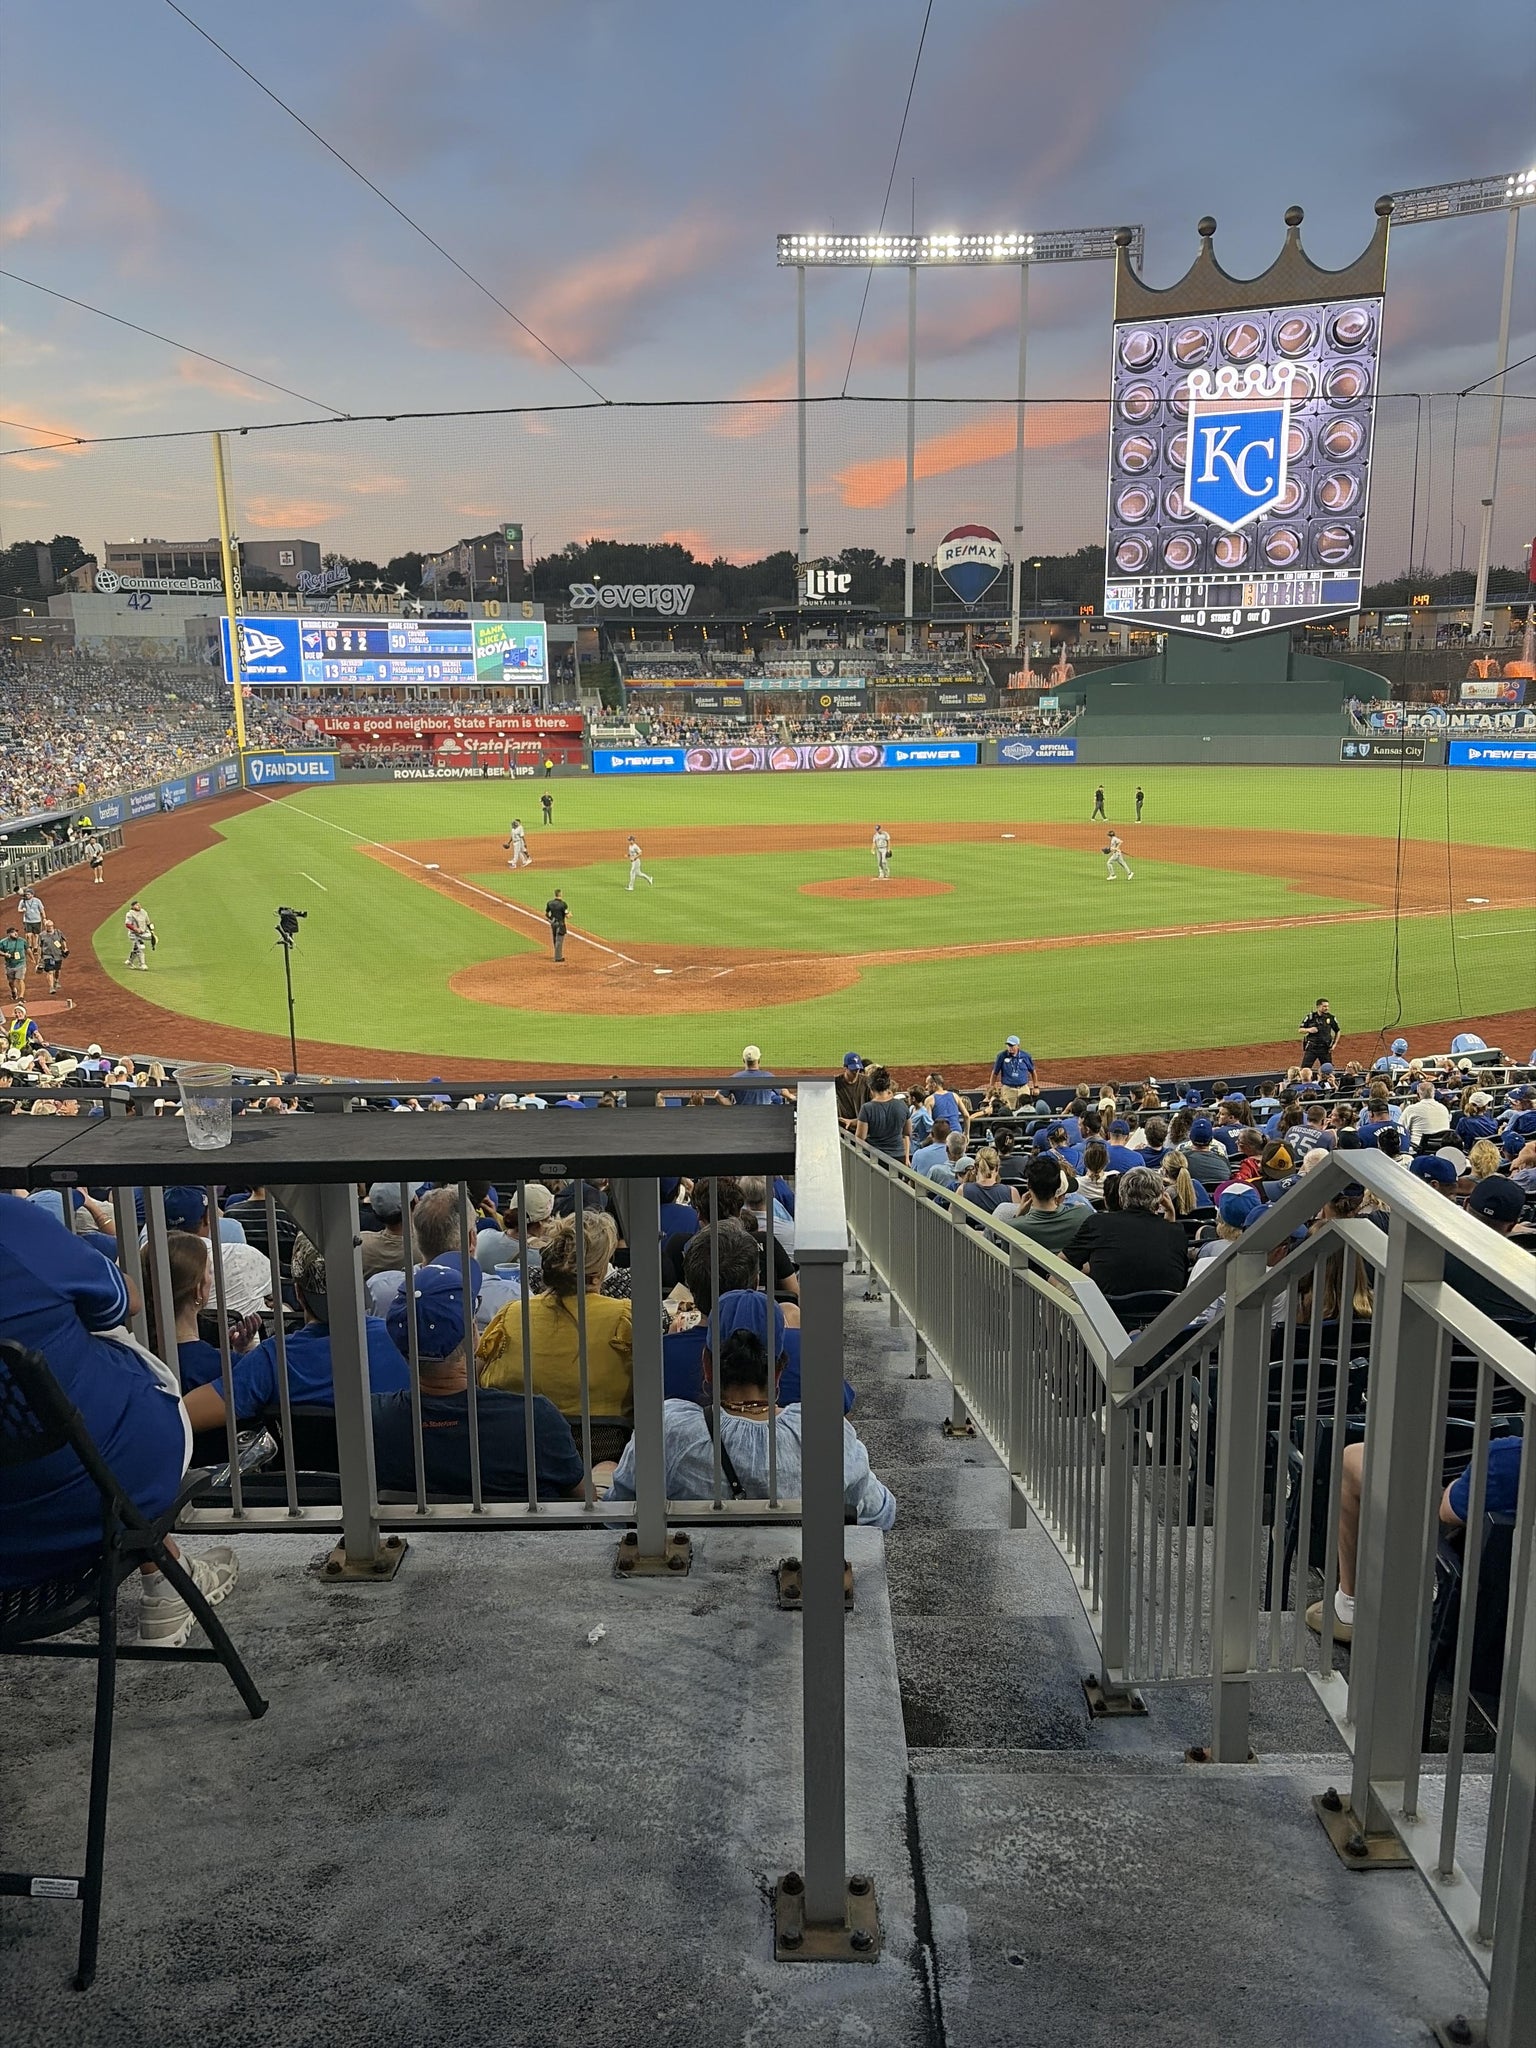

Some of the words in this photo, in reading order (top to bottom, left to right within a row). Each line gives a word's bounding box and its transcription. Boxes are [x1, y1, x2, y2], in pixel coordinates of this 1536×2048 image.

[1197, 425, 1274, 496] KC
[946, 545, 996, 560] RE/MAX
[121, 576, 187, 589] Commerce
[189, 577, 222, 590] Bank
[296, 565, 351, 595] Royals
[804, 570, 852, 600] Lite
[1118, 587, 1133, 598] TOR
[1137, 588, 1143, 598] 2
[1150, 587, 1155, 597] 0
[1162, 587, 1166, 597] 1
[1174, 586, 1179, 596] 0
[1186, 586, 1191, 596] 0
[1197, 585, 1203, 595] 0
[1248, 584, 1253, 593] 3
[1260, 584, 1268, 593] 10
[1273, 583, 1278, 593] 0
[1285, 583, 1291, 592] 7
[1299, 582, 1304, 592] 3
[1312, 582, 1316, 591] 1
[128, 593, 152, 610] 42
[246, 590, 312, 611] HALL
[316, 595, 336, 615] of
[337, 593, 401, 613] FAME
[601, 588, 691, 612] evergy
[1119, 600, 1131, 610] KC
[1137, 600, 1143, 609] 2
[1149, 599, 1155, 609] 0
[1161, 599, 1166, 608] 0
[1174, 598, 1178, 608] 1
[1185, 598, 1191, 608] 0
[1248, 597, 1252, 605] 3
[1260, 596, 1265, 605] 4
[1273, 596, 1277, 604] 1
[1285, 595, 1290, 604] 3
[1298, 594, 1303, 604] 3
[1312, 594, 1315, 603] 1
[1413, 594, 1430, 605] 1:49
[482, 600, 500, 617] 10
[522, 601, 534, 617] 5
[1080, 605, 1094, 616] 1:49
[1180, 614, 1195, 623] BALL
[1197, 610, 1206, 626] 0
[1210, 613, 1231, 622] STRIKE
[1232, 610, 1241, 625] 0
[1247, 613, 1260, 621] OUT
[1261, 609, 1270, 624] 0
[480, 624, 504, 637] BANK
[327, 637, 336, 650] 0
[343, 637, 351, 650] 2
[359, 637, 367, 650] 2
[391, 635, 406, 648] 50
[480, 634, 499, 646] LIKE
[501, 632, 507, 640] A
[477, 637, 517, 658] ROYAL
[325, 664, 339, 678] 13
[379, 664, 387, 678] 9
[427, 665, 440, 678] 19
[834, 695, 857, 703] planet
[324, 719, 350, 730] Like
[353, 722, 360, 730] a
[363, 718, 392, 732] good
[396, 717, 451, 731] neighbor,
[454, 716, 485, 728] State
[489, 717, 519, 728] Farm
[522, 716, 531, 728] is
[535, 715, 569, 727] there.
[1408, 713, 1516, 728] FOUNTAIN
[1374, 746, 1402, 755] Kansas
[1405, 746, 1423, 757] City
[265, 762, 329, 776] FANDUEL
[1288, 1132, 1318, 1157] 35
